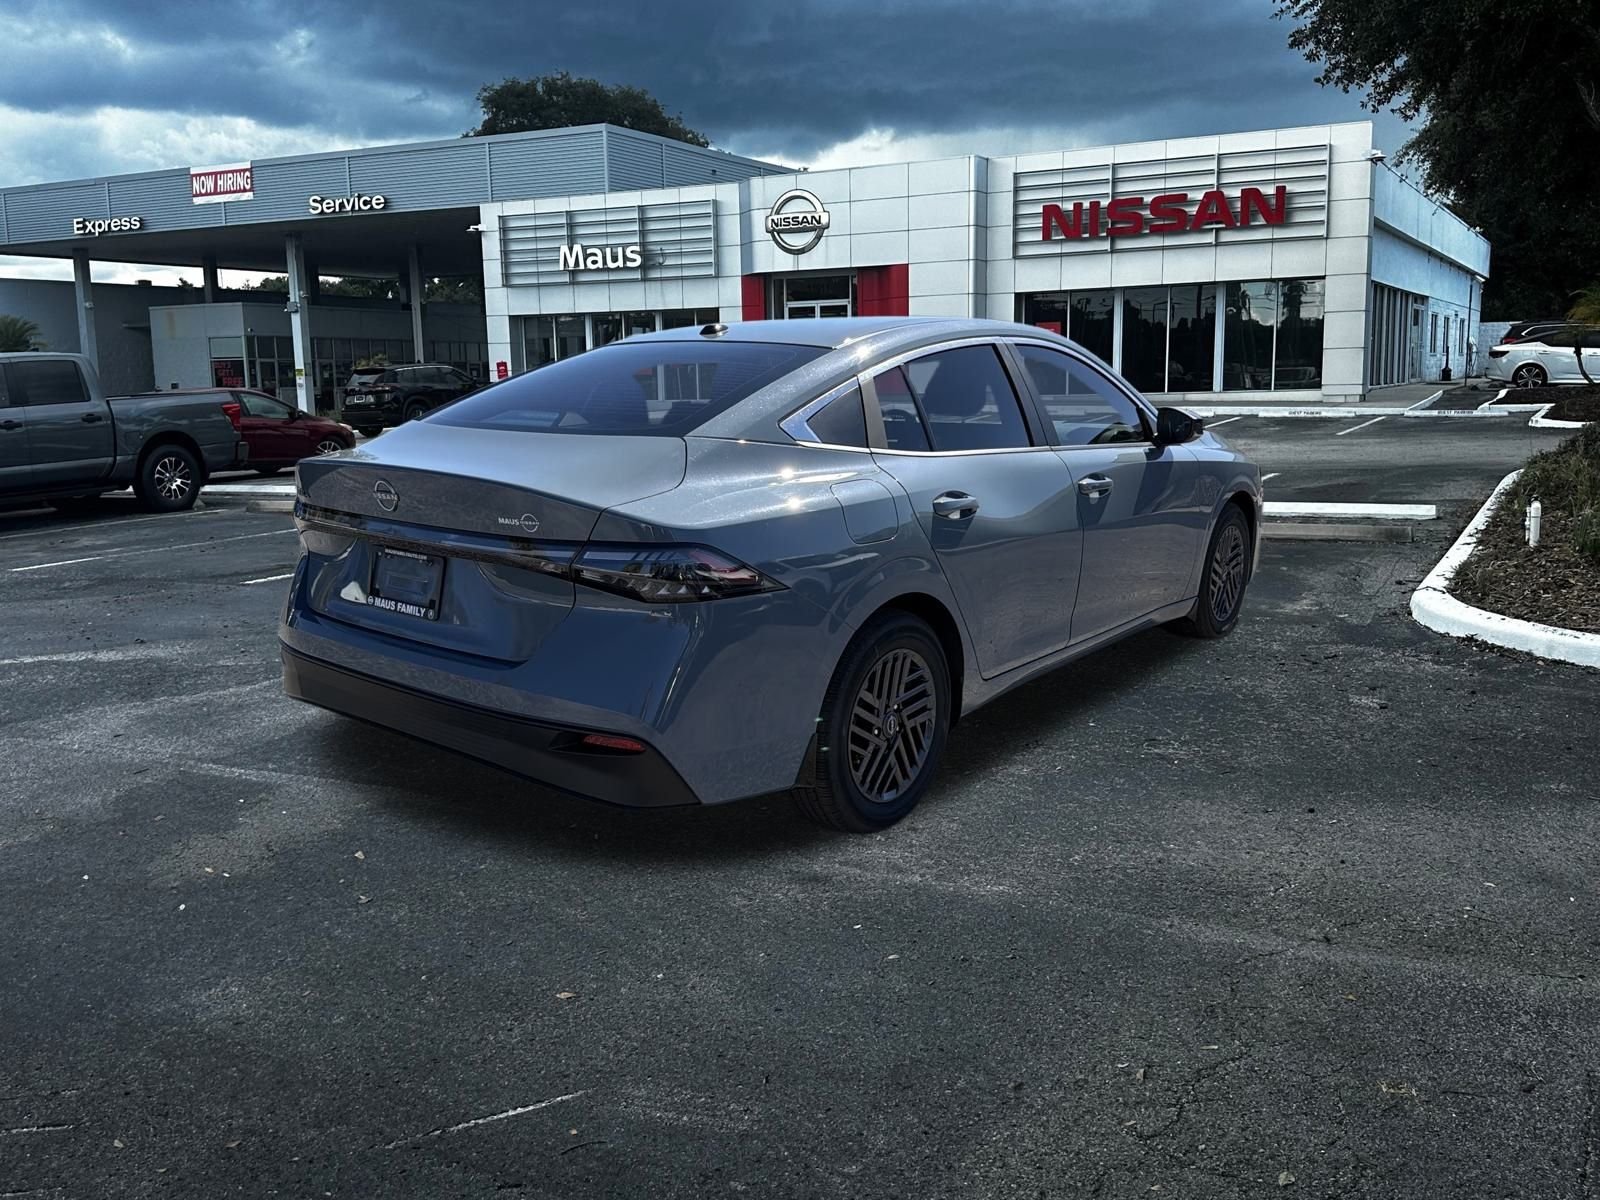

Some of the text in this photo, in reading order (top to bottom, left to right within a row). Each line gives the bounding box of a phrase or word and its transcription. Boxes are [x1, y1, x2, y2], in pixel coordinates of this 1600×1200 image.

[193, 171, 251, 195] NOW HIRING
[309, 193, 385, 215] Service
[1042, 185, 1287, 241] NISSAN
[73, 216, 141, 237] Express
[771, 215, 821, 228] NISSAN
[560, 243, 642, 270] Maus
[498, 517, 520, 526] MAUS
[374, 597, 426, 617] MAUS FAMILY
